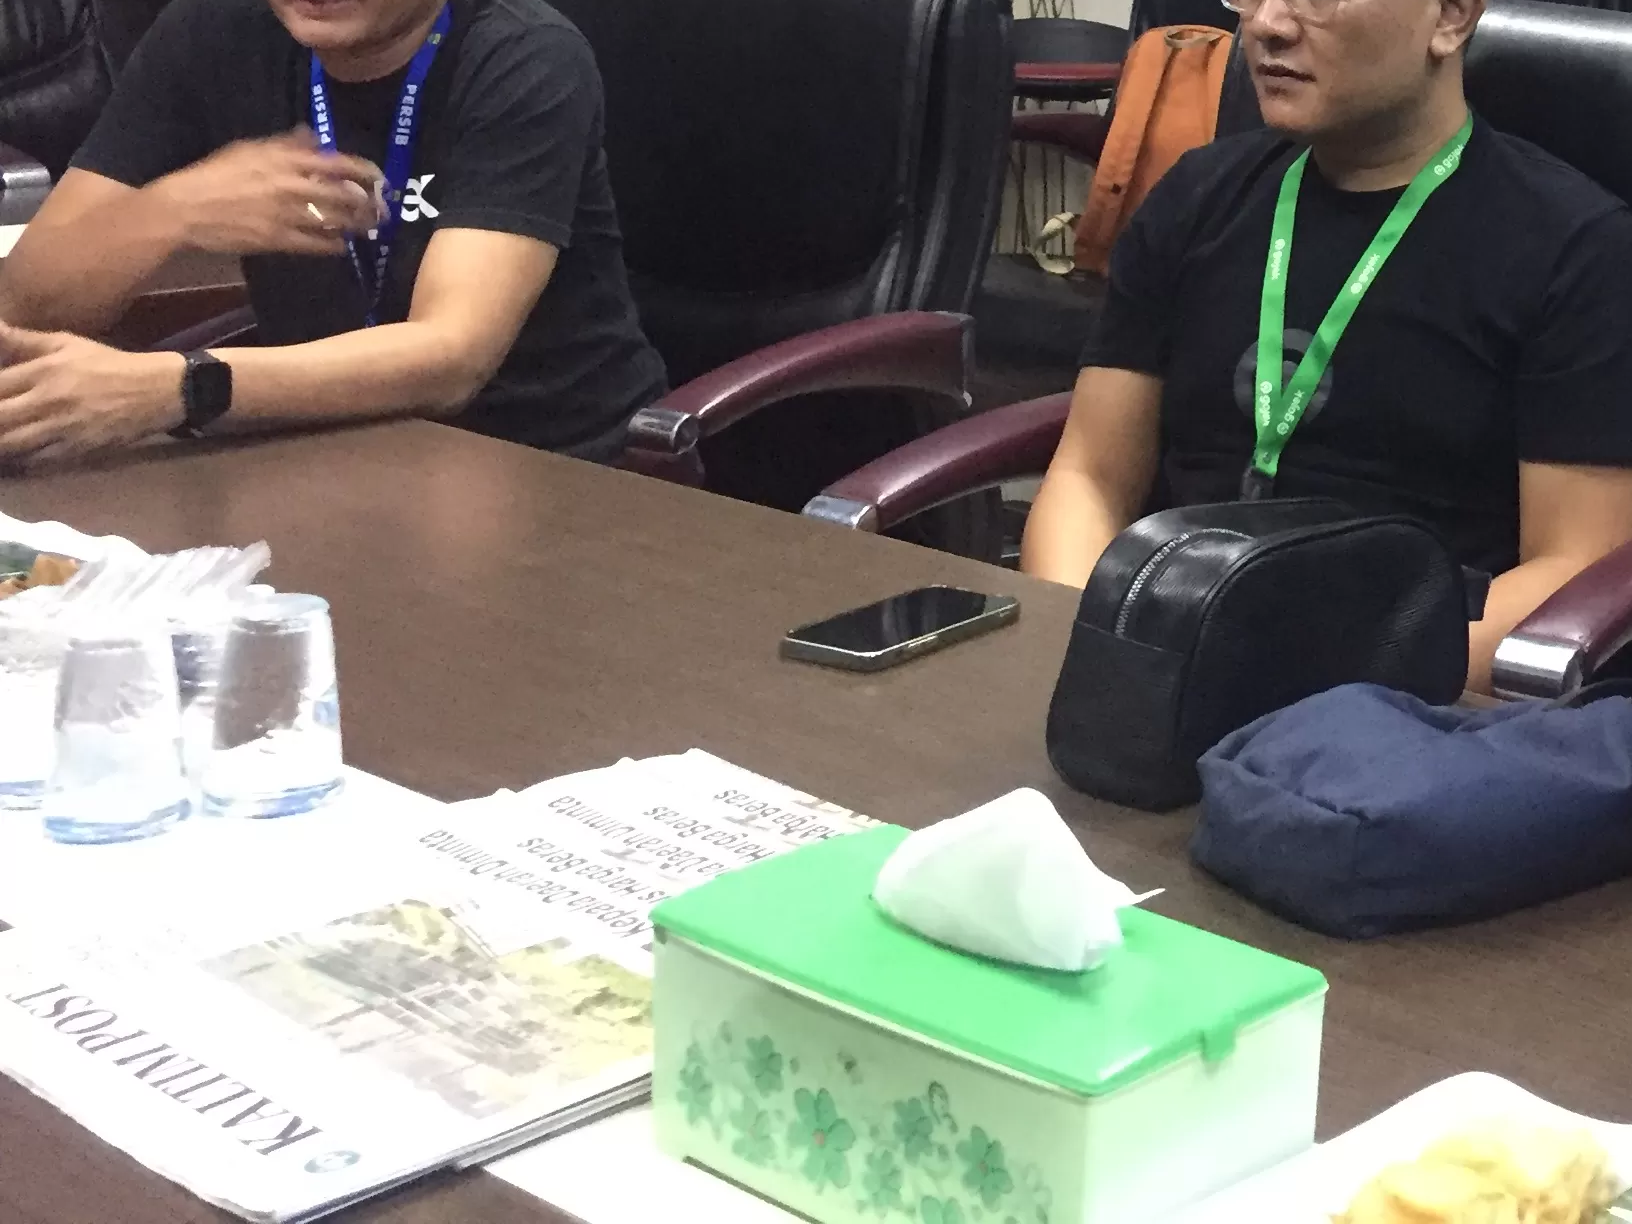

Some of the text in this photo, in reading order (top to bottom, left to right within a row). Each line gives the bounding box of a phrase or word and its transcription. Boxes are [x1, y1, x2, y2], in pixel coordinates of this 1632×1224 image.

[312, 83, 332, 145] PERSIB
[394, 83, 418, 146] PERSIB
[1442, 143, 1465, 169] gojek
[1284, 389, 1306, 424] gojek
[642, 805, 713, 839] Beras
[516, 837, 589, 874] Beras
[700, 830, 776, 864] Harga
[417, 829, 653, 939] Kepala Daerah Diminta
[575, 864, 651, 898] Harga
[5, 982, 324, 1156] KALTIM POST
